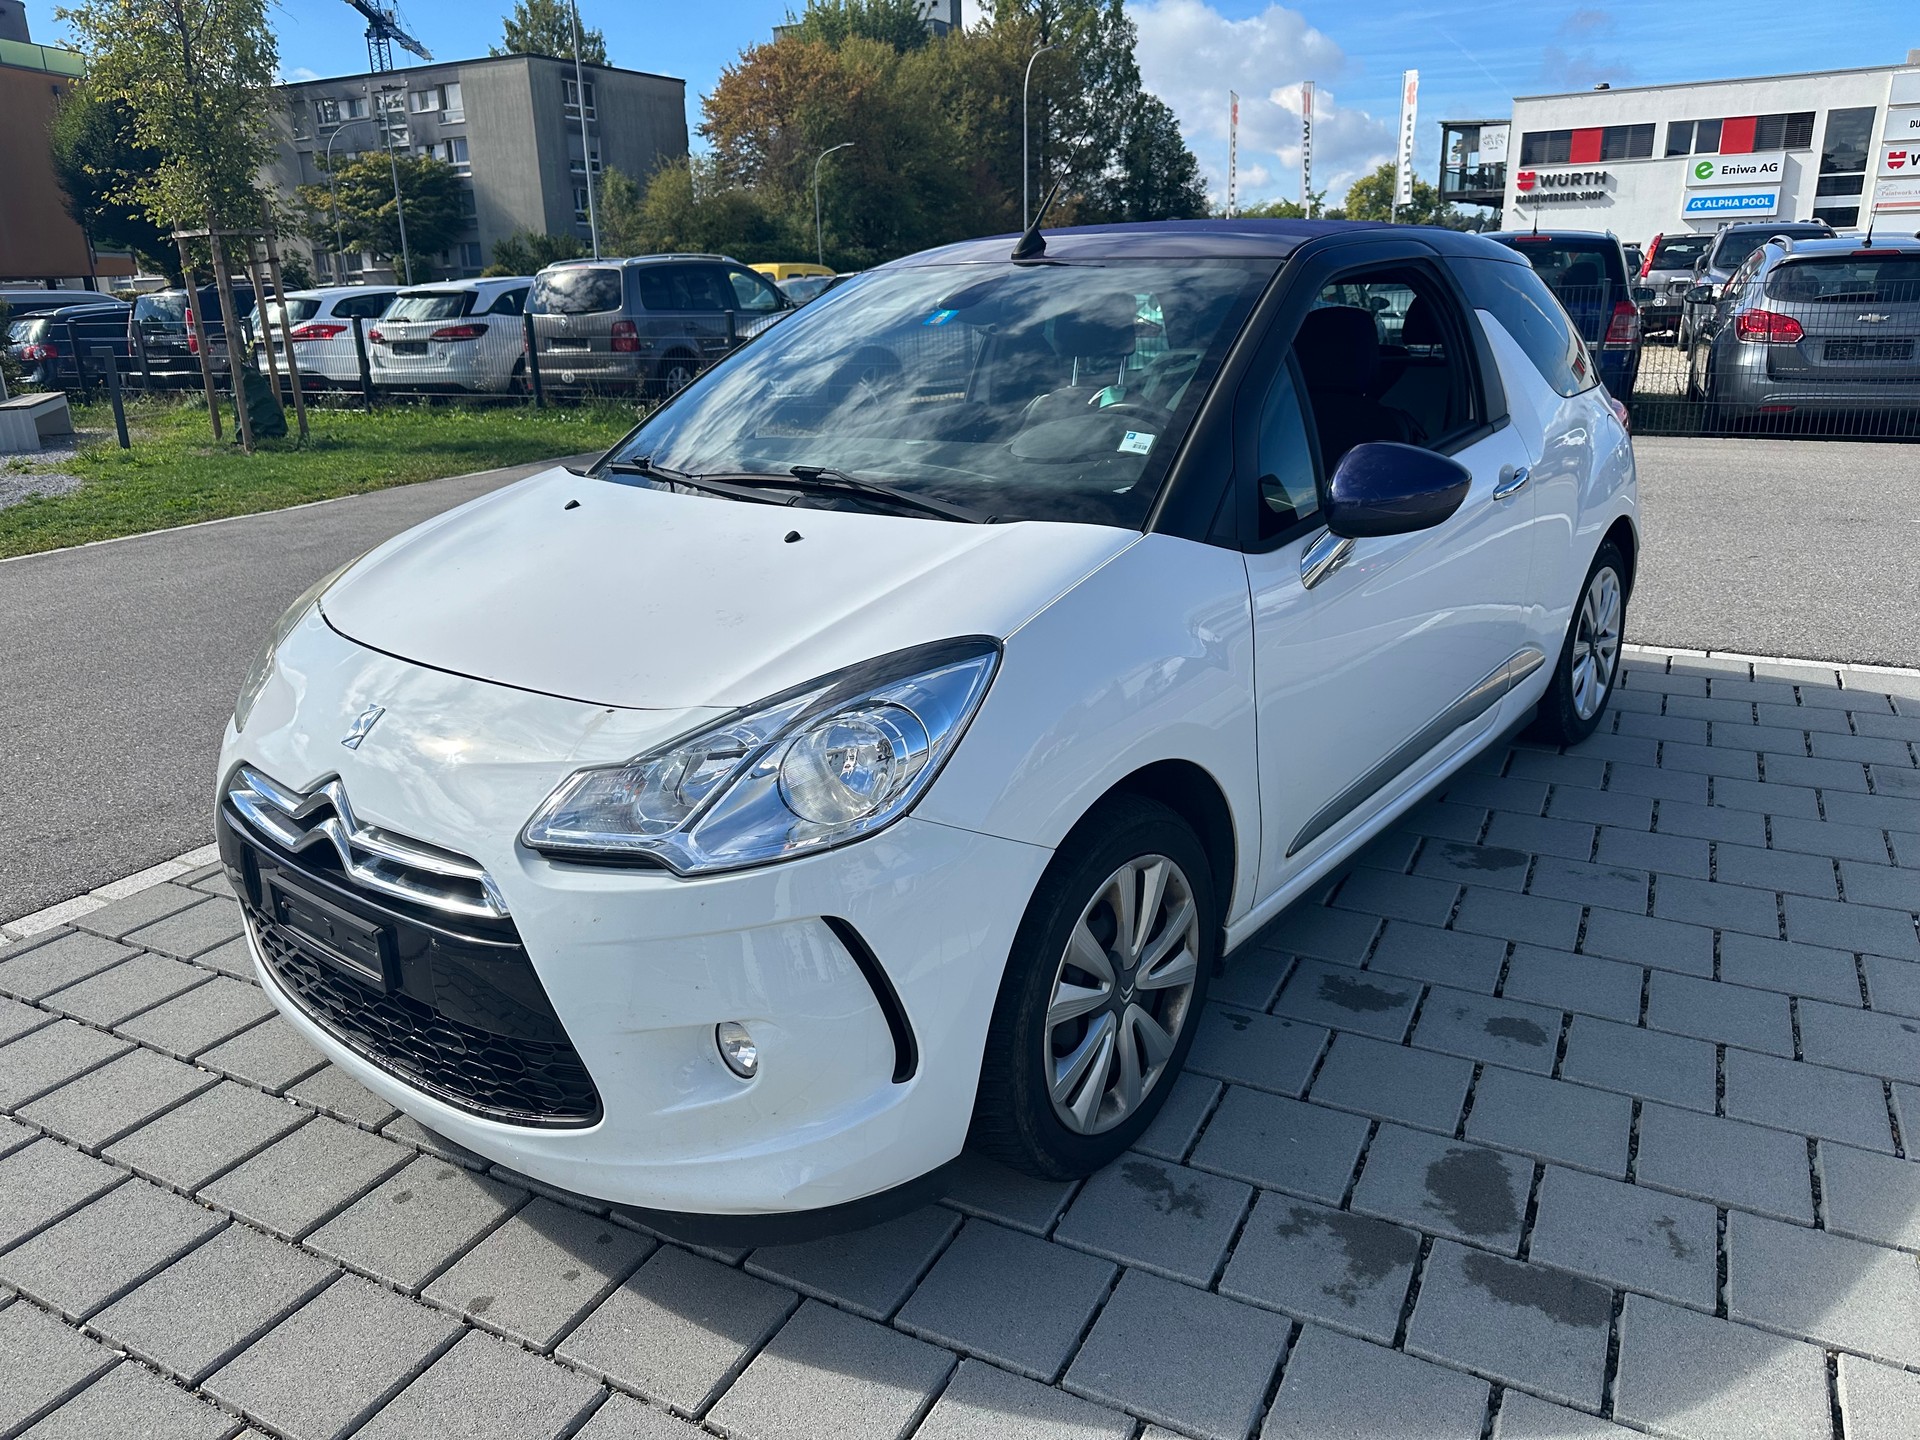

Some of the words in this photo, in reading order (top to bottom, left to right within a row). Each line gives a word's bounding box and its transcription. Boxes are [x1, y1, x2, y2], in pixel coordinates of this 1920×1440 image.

[1721, 164, 1757, 175] Eniwa
[1759, 162, 1778, 173] AG
[1539, 171, 1607, 188] WÜRTH
[1515, 191, 1605, 204] HANDWERKER-SHOP
[1704, 198, 1740, 208] ALPHA
[1741, 197, 1771, 207] POOL
